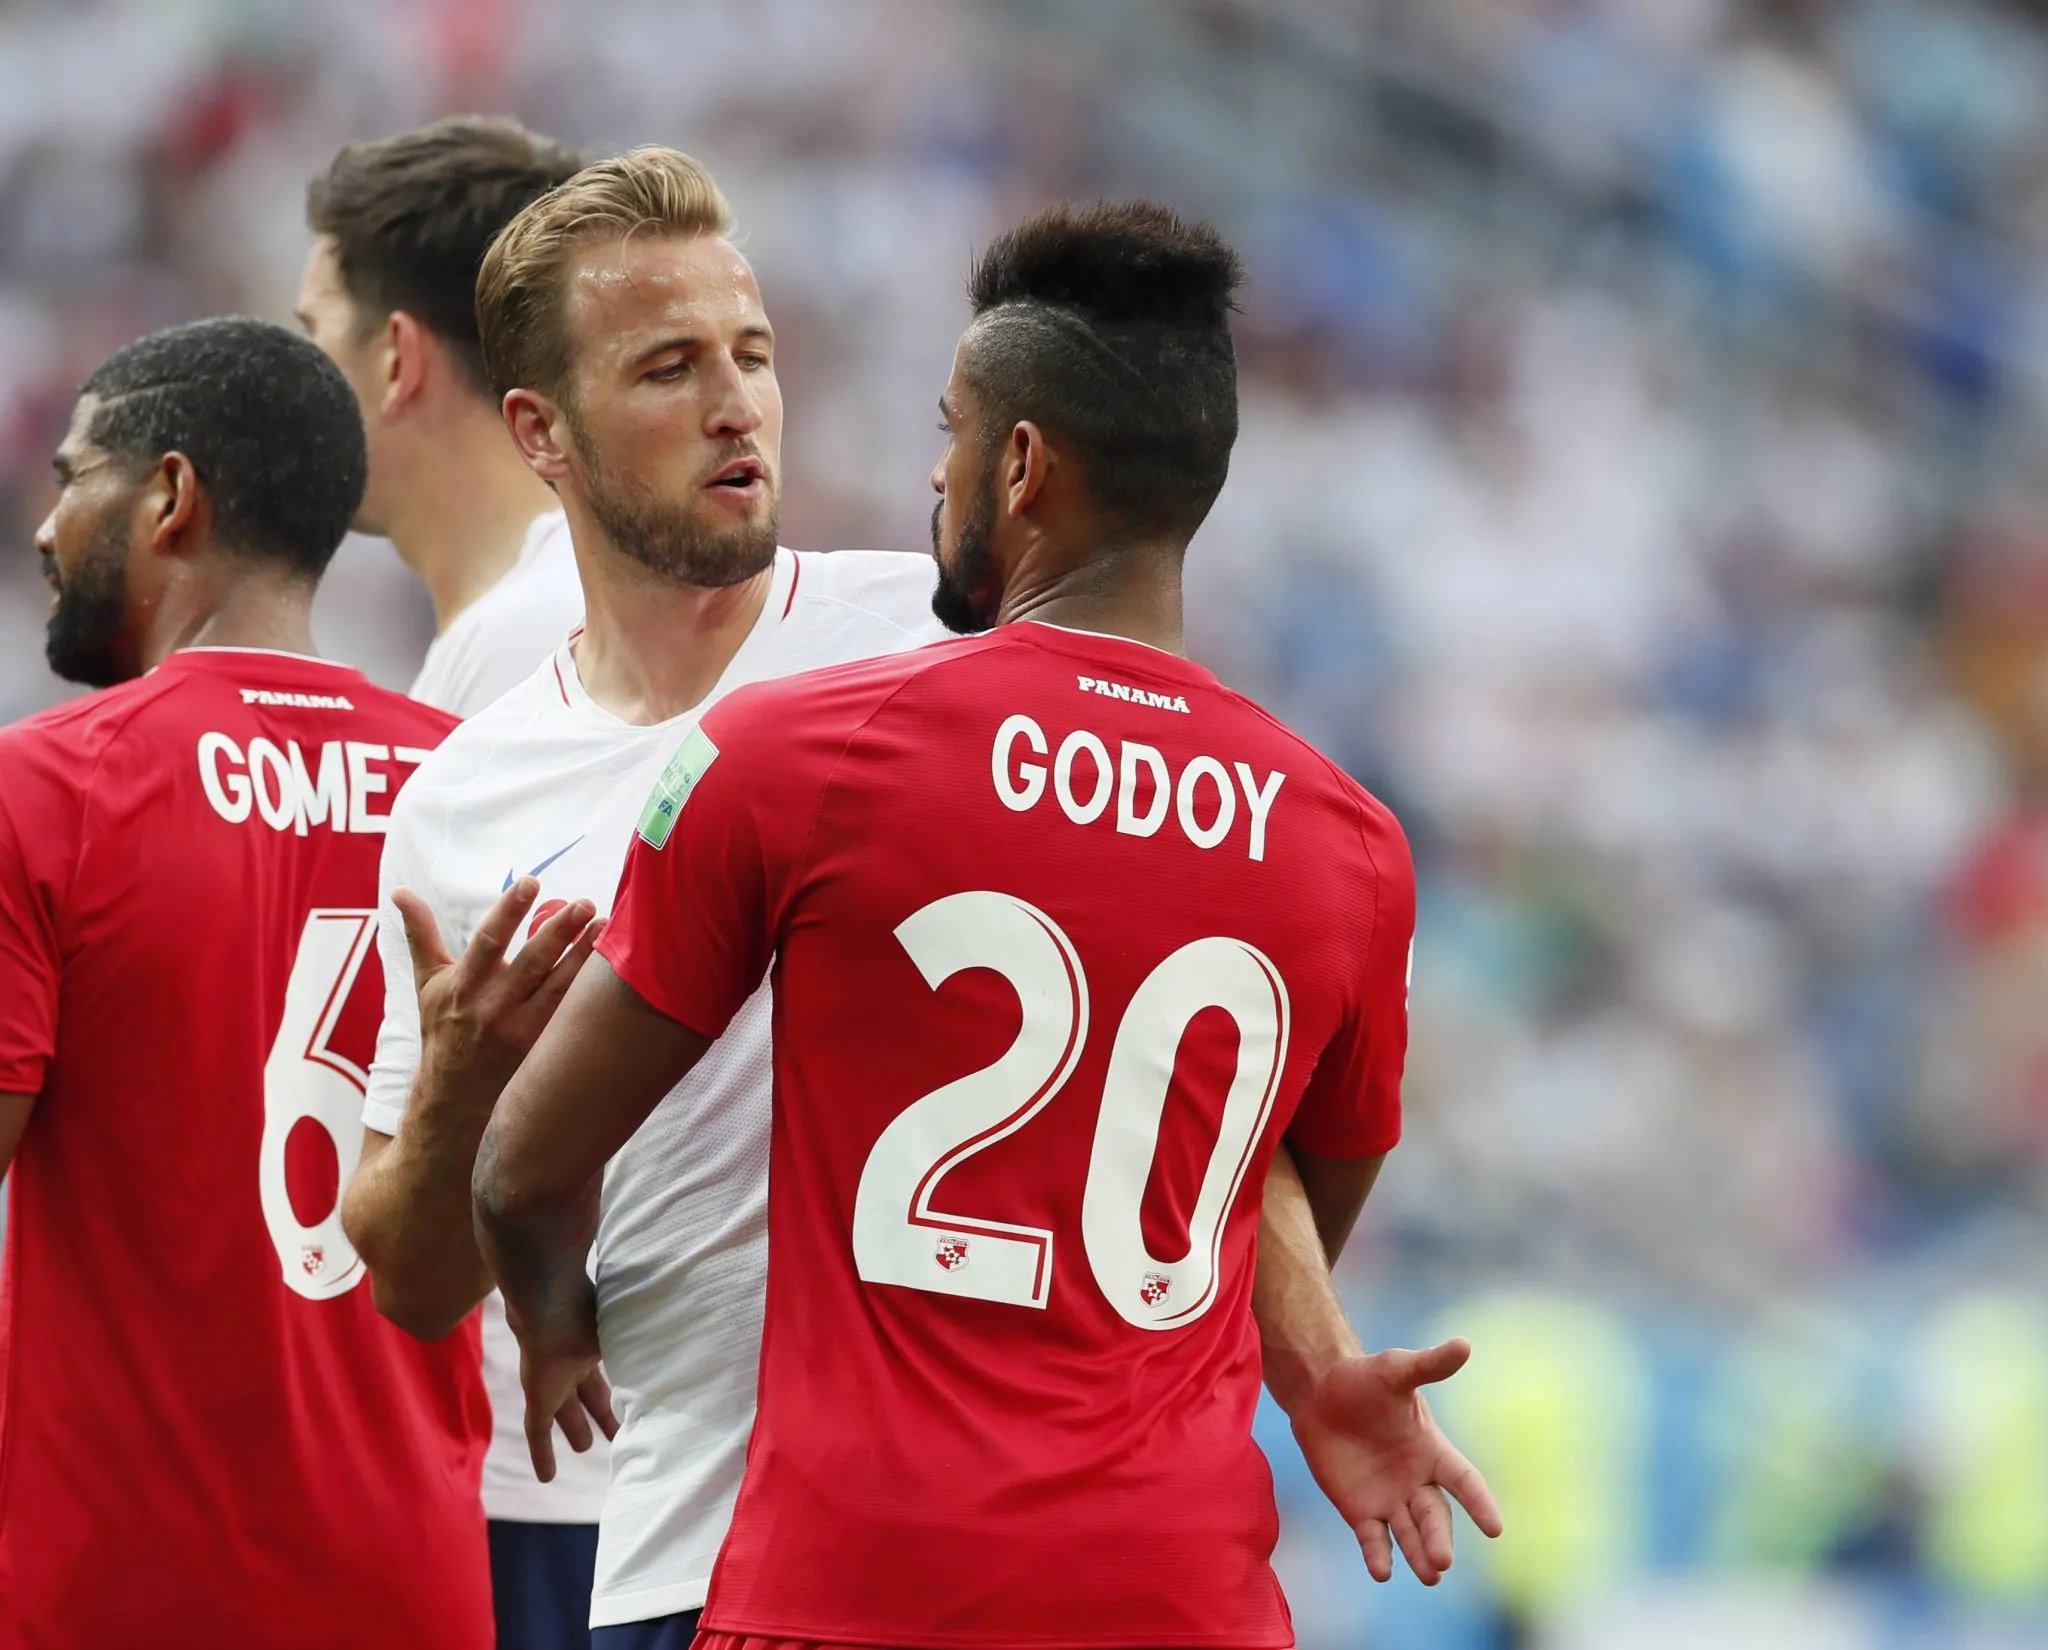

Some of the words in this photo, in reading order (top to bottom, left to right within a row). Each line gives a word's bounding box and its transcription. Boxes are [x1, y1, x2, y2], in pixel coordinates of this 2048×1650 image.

[991, 714, 1287, 862] GODOY
[1077, 676, 1190, 714] PANAMÁ
[259, 908, 379, 1300] 6
[853, 890, 1290, 1331] 20
